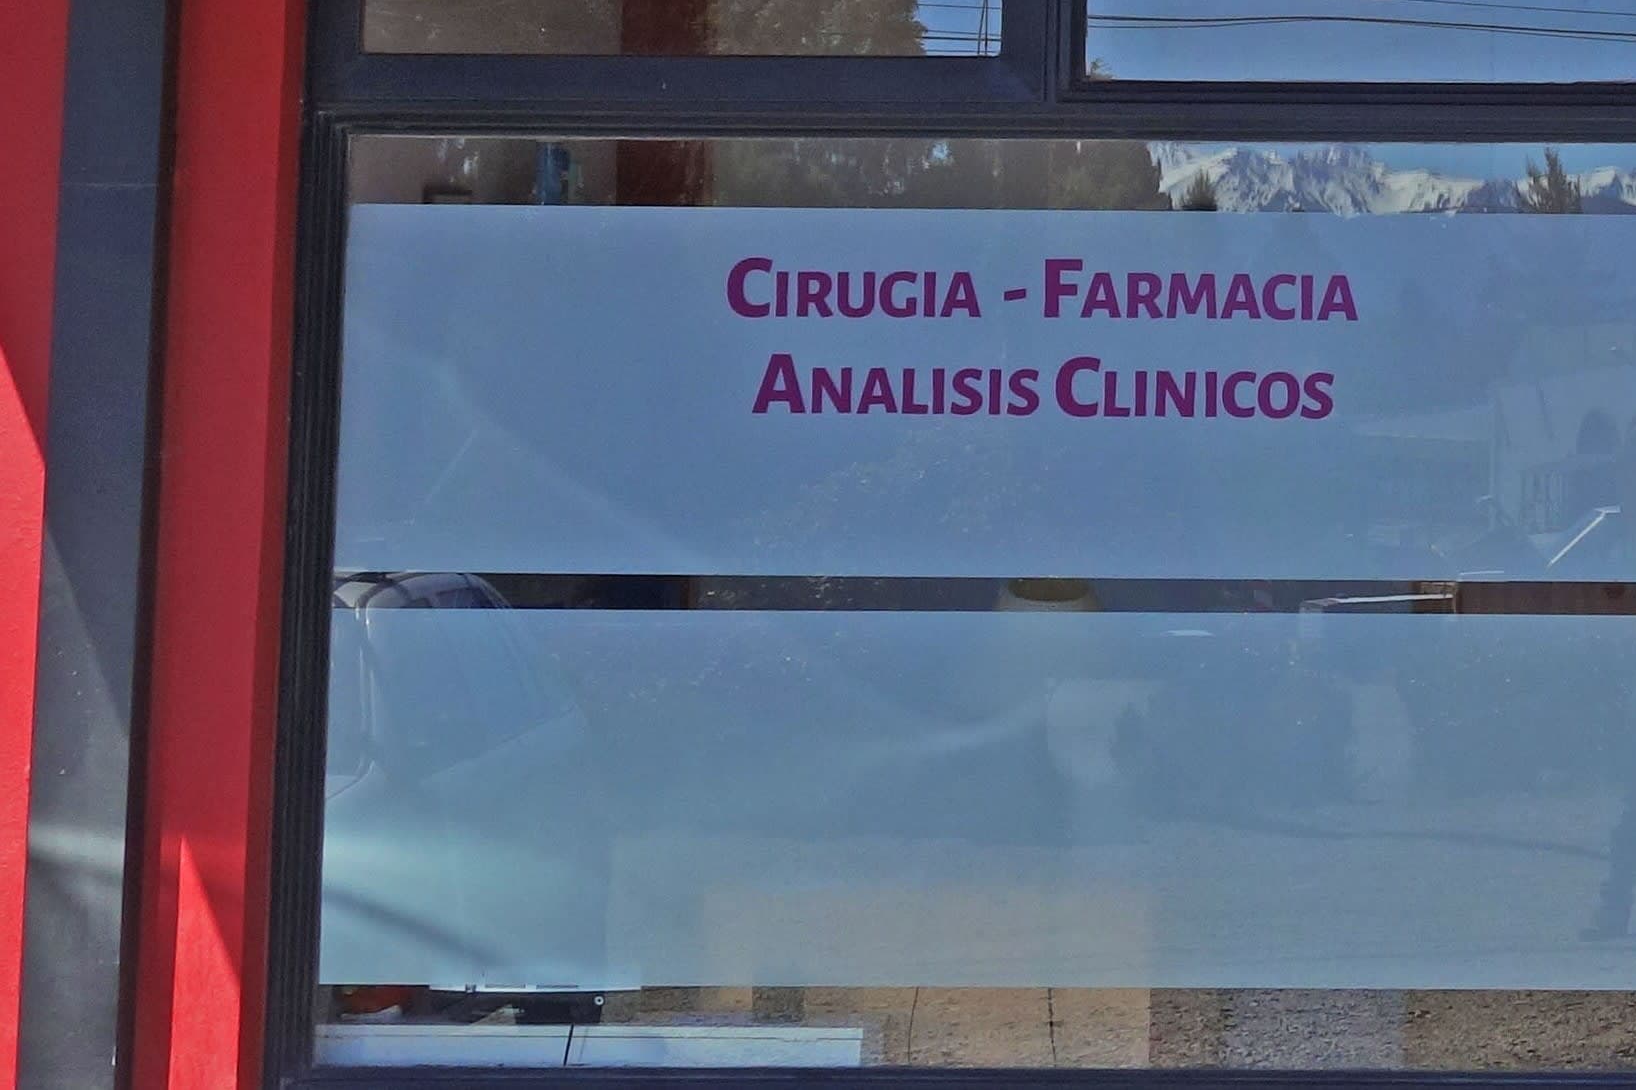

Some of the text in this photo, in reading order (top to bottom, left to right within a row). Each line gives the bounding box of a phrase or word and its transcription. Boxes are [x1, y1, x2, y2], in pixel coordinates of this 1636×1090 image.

[725, 256, 982, 319] CIRUGIA
[1042, 257, 1359, 322] FARMACIA
[752, 352, 1335, 420] ANALISIS CLINICOS
